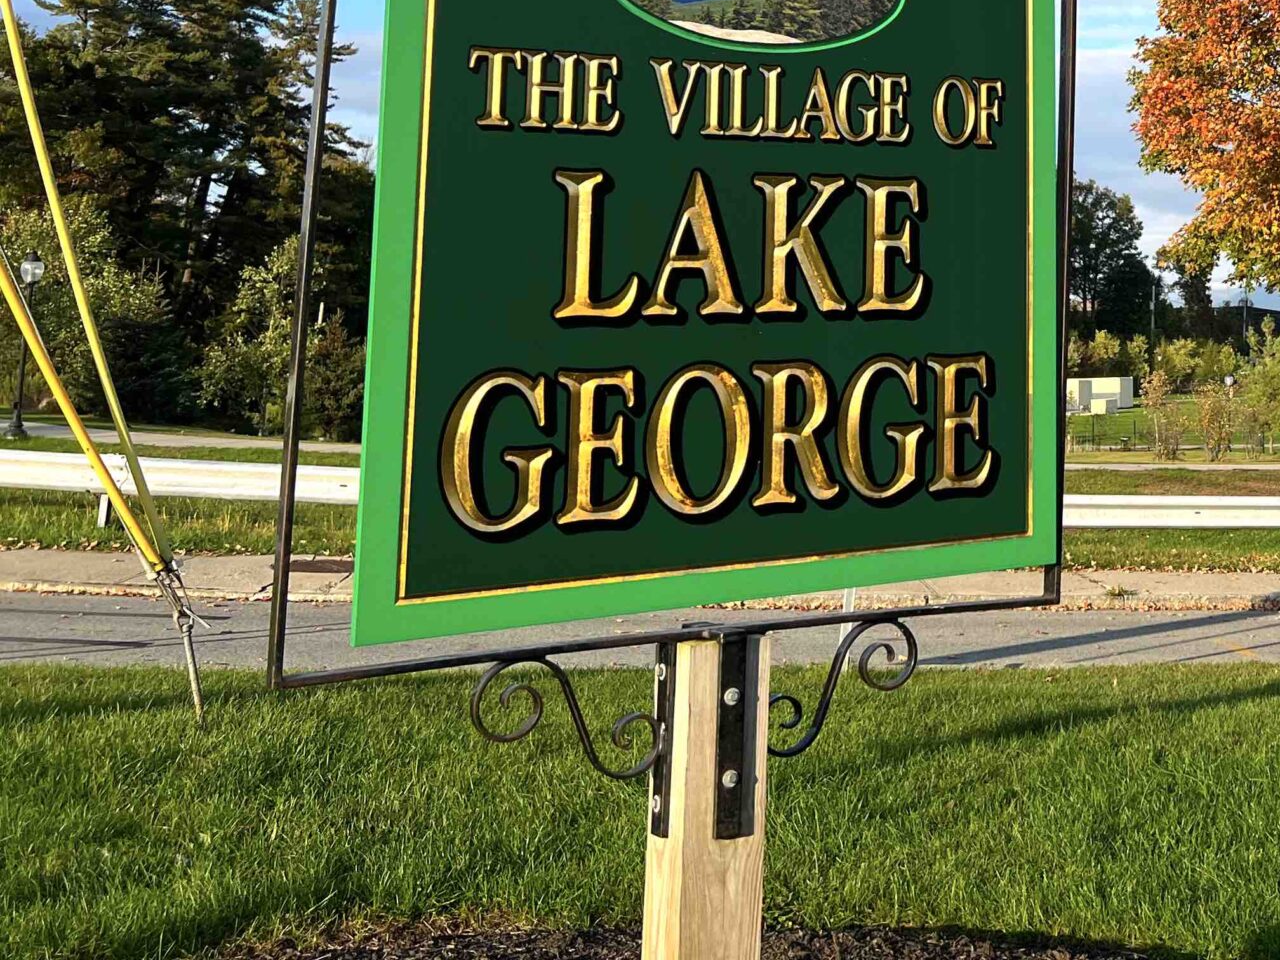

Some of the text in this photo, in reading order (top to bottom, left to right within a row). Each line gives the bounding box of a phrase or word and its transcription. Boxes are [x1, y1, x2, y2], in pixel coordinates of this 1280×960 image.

[469, 48, 1004, 145] THE VILLAGE OF
[554, 170, 924, 318] LAKE
[440, 354, 992, 532] GEORGE
